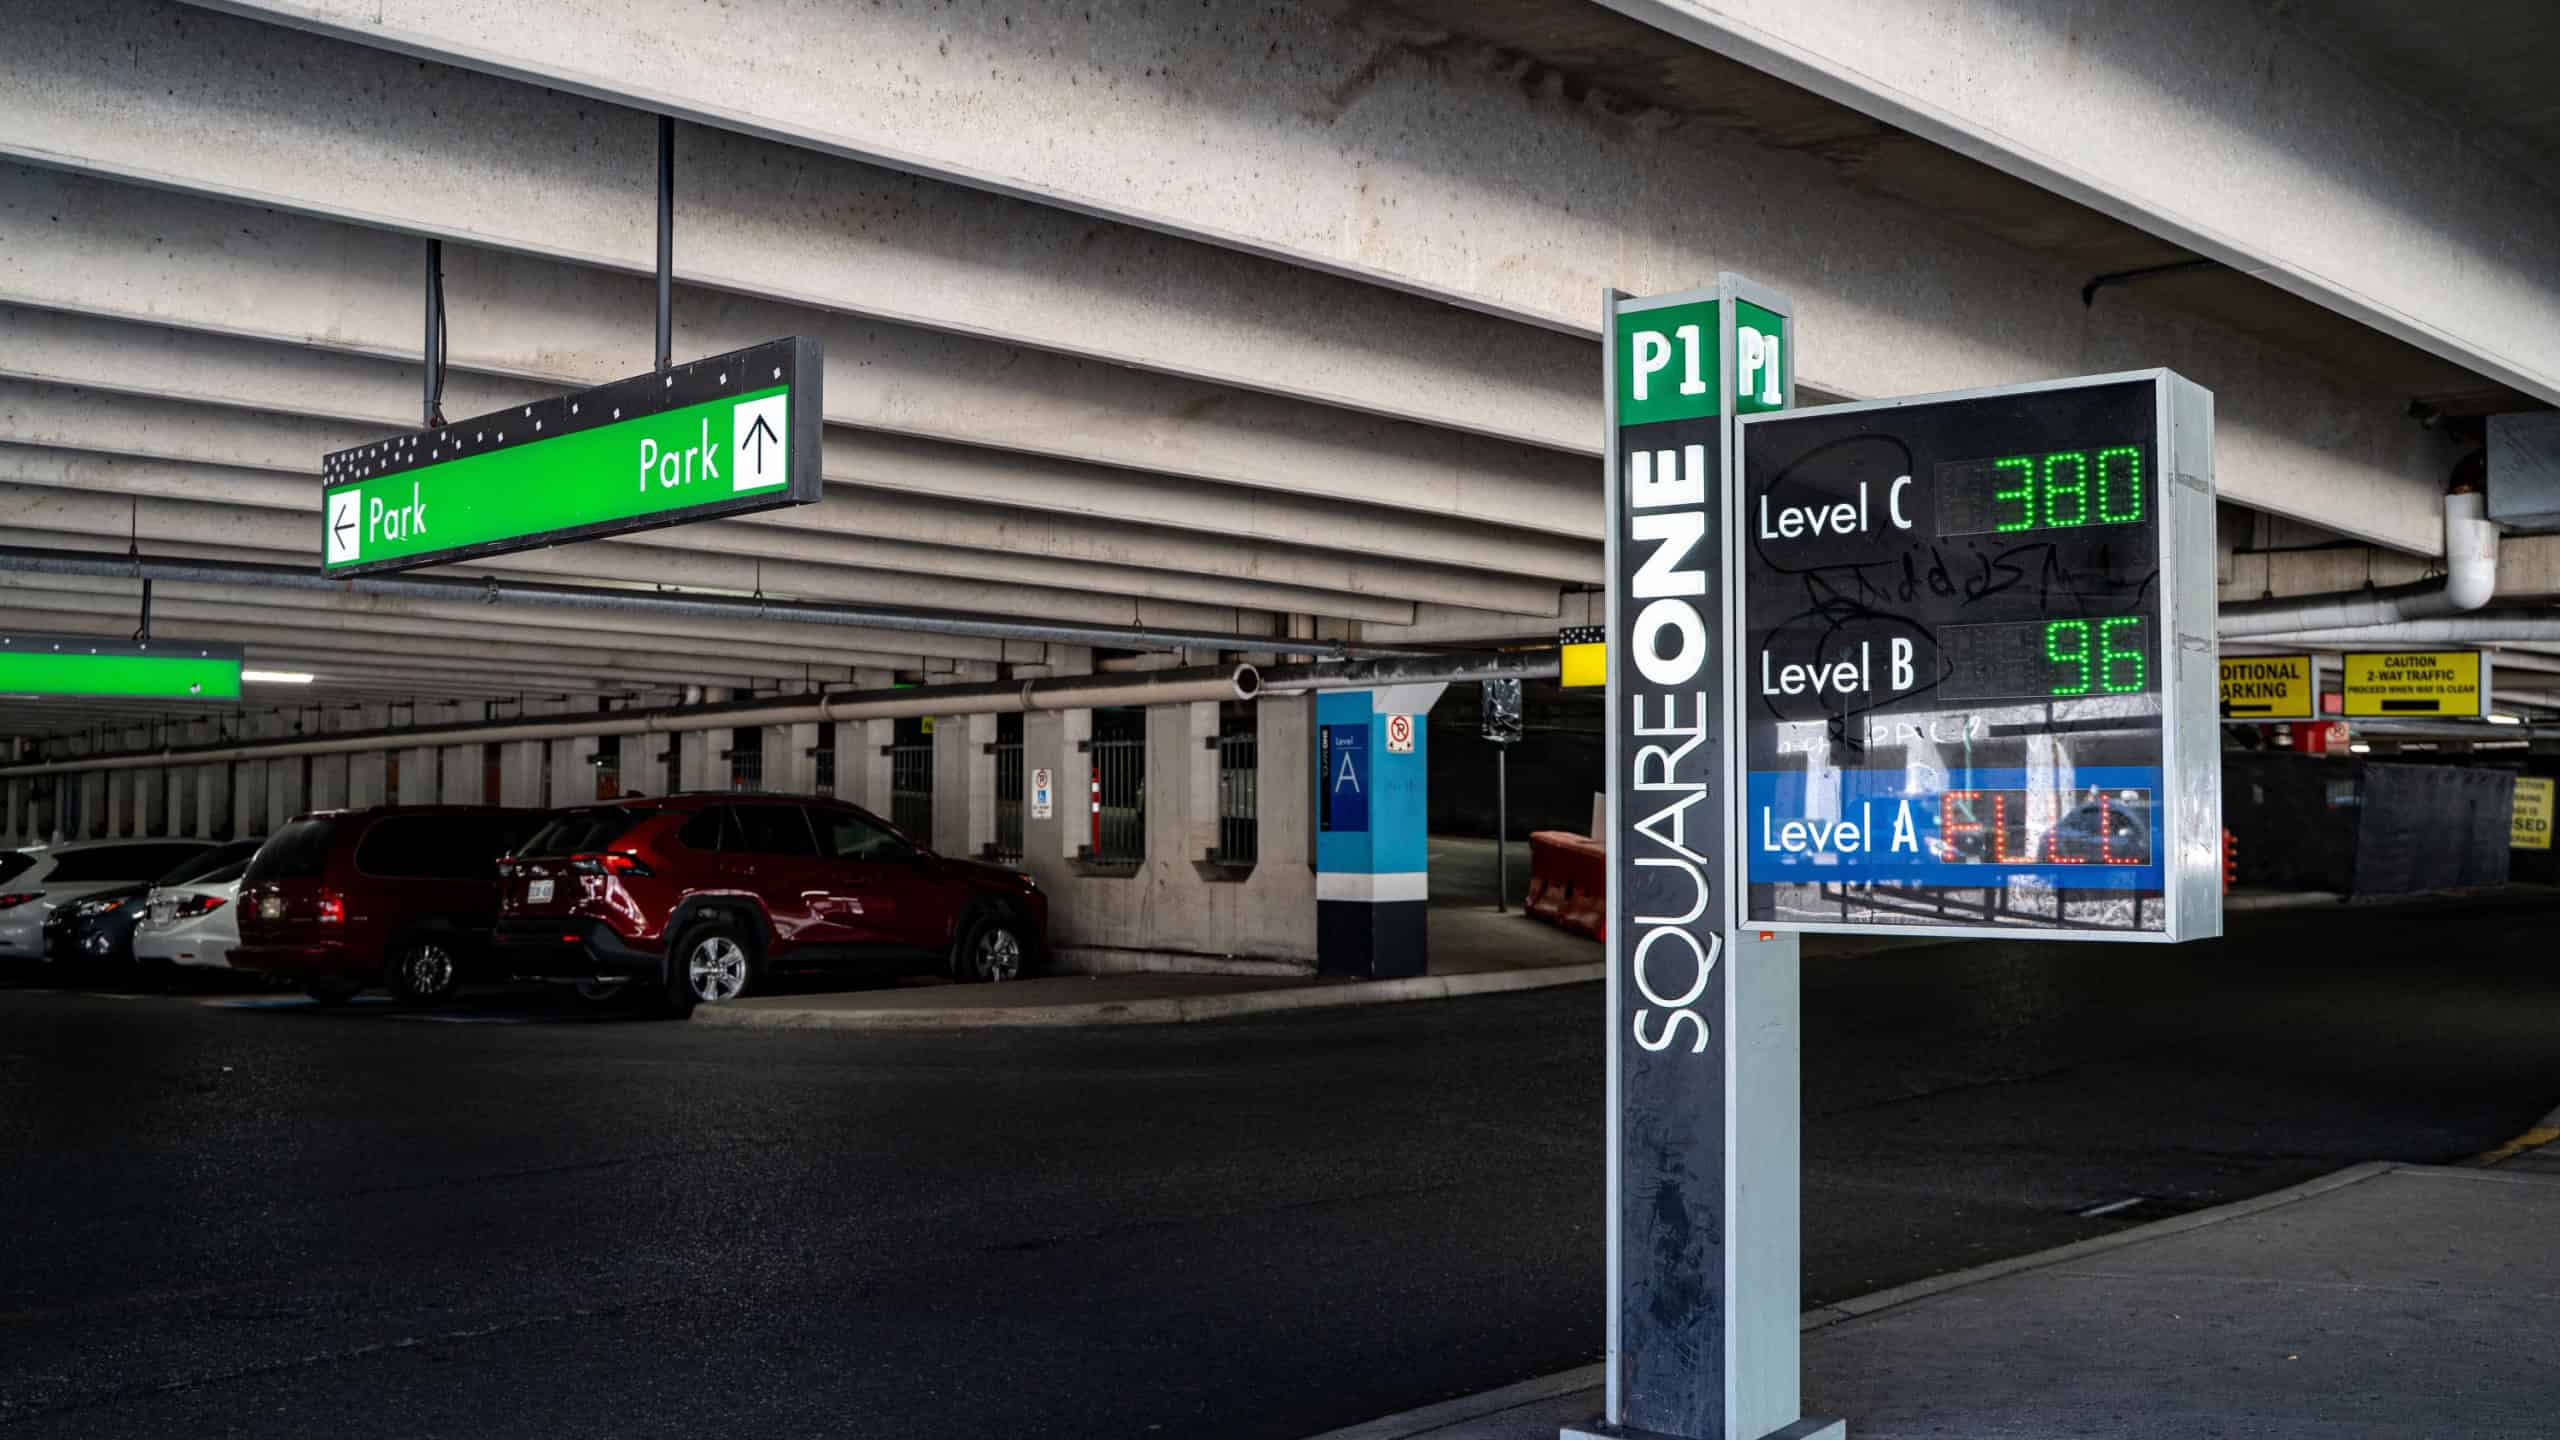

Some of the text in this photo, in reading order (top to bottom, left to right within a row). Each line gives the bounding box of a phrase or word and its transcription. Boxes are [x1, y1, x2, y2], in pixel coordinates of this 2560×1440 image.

[1632, 325, 1706, 400] P1
[1738, 326, 1782, 405] P1
[640, 417, 719, 493] Park
[368, 481, 427, 544] Park
[1760, 475, 1913, 540] Level C
[1996, 446, 2141, 532] 380
[1761, 638, 1914, 696] Level B
[2046, 616, 2144, 695] 96
[2220, 663, 2301, 680] DITIONAL
[2367, 669, 2455, 682] 2-WAY TRAFFIC
[2384, 656, 2436, 667] CAUTION
[2220, 682, 2288, 699] ARKING
[1336, 735, 1354, 746] Level
[1632, 444, 1724, 1054] SQUARE ONE
[1335, 751, 1360, 793] A
[1762, 799, 1920, 853] Level A
[1944, 791, 2140, 866] FULL
[2513, 817, 2548, 832] SED
